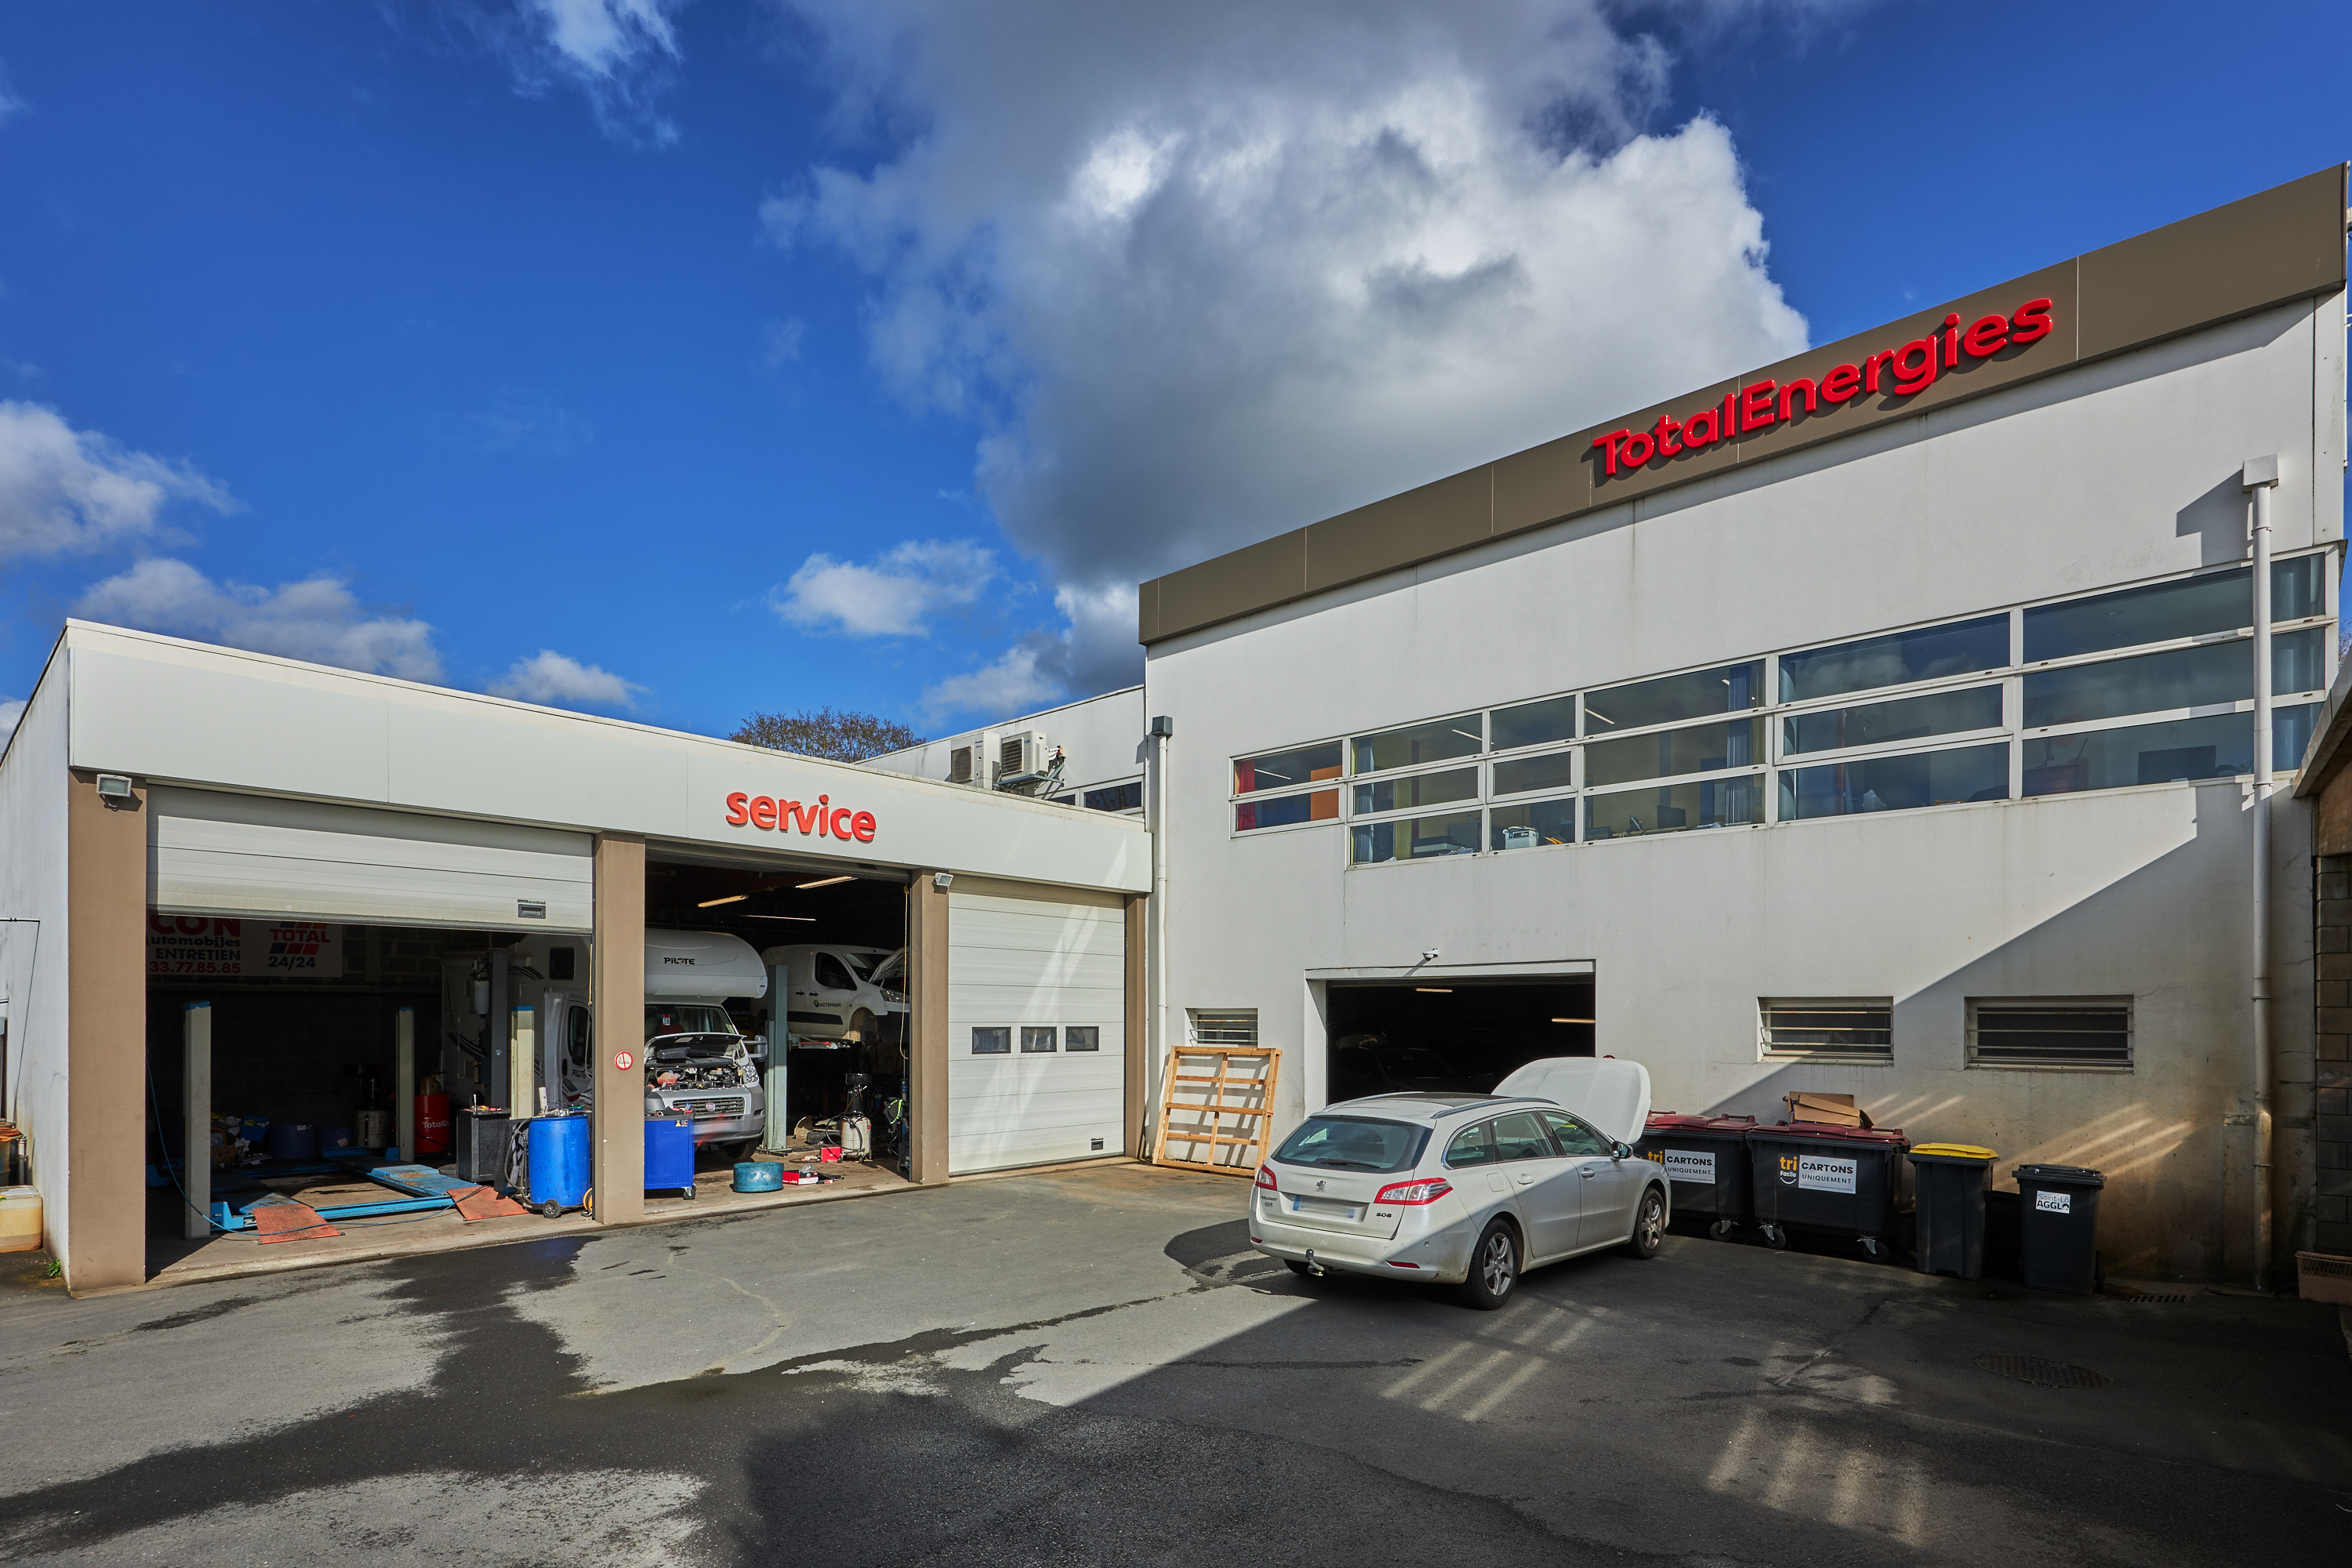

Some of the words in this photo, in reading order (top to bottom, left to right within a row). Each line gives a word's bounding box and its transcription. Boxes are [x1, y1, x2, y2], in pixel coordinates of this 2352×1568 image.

[1593, 297, 2054, 475] TotalEnergies
[726, 792, 877, 841] service
[270, 928, 331, 943] TOTAL
[156, 948, 241, 960] ENTRETIEN
[268, 956, 317, 971] 24/24
[1647, 1151, 1663, 1164] tri
[1666, 1156, 1712, 1166] CARTONS
[1780, 1156, 1797, 1171] tri
[1801, 1162, 1853, 1174] CARTONS
[1802, 1174, 1852, 1184] UNIQUEMENT
[2038, 1193, 2070, 1203] Saint-Lô
[2037, 1200, 2070, 1210] AGGLO
